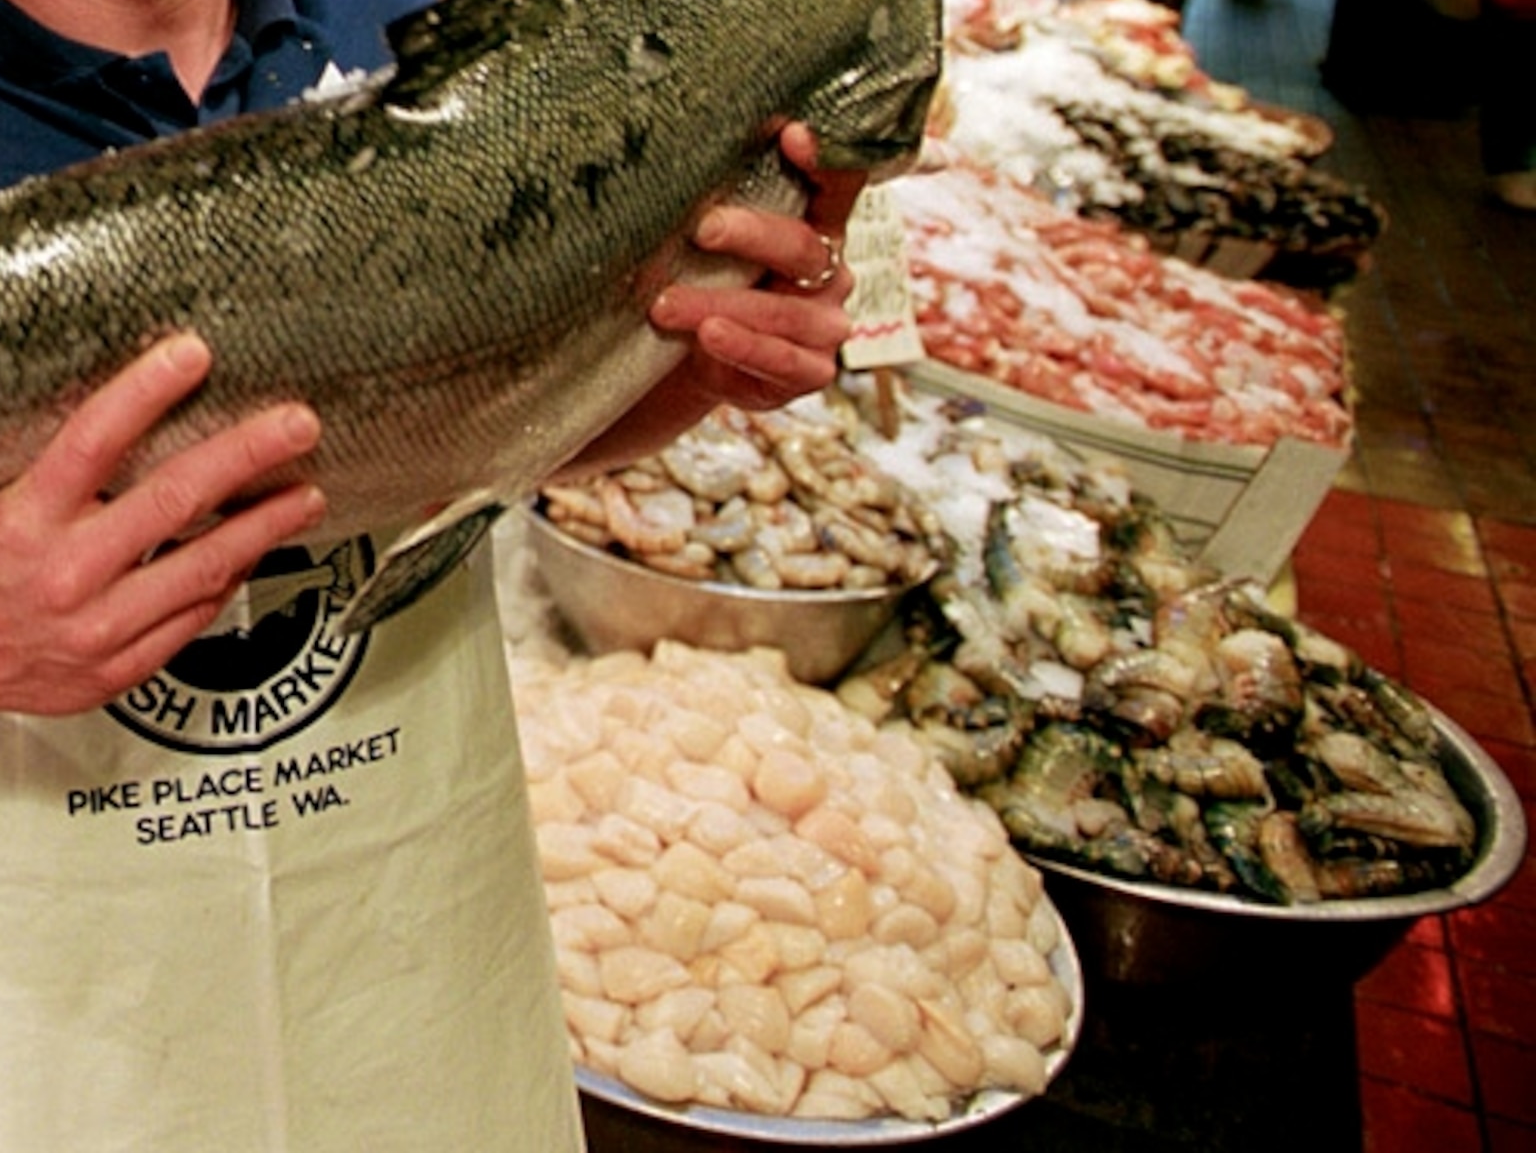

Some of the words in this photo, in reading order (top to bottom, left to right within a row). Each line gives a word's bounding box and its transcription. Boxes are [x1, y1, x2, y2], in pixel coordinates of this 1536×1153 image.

[126, 670, 197, 731] SH
[210, 595, 350, 735] MARKET
[67, 779, 142, 816] PIKE
[151, 766, 263, 807] PLACE
[273, 726, 403, 789] MARKET
[135, 798, 280, 847] SEATTLE
[291, 783, 351, 819] WA.
